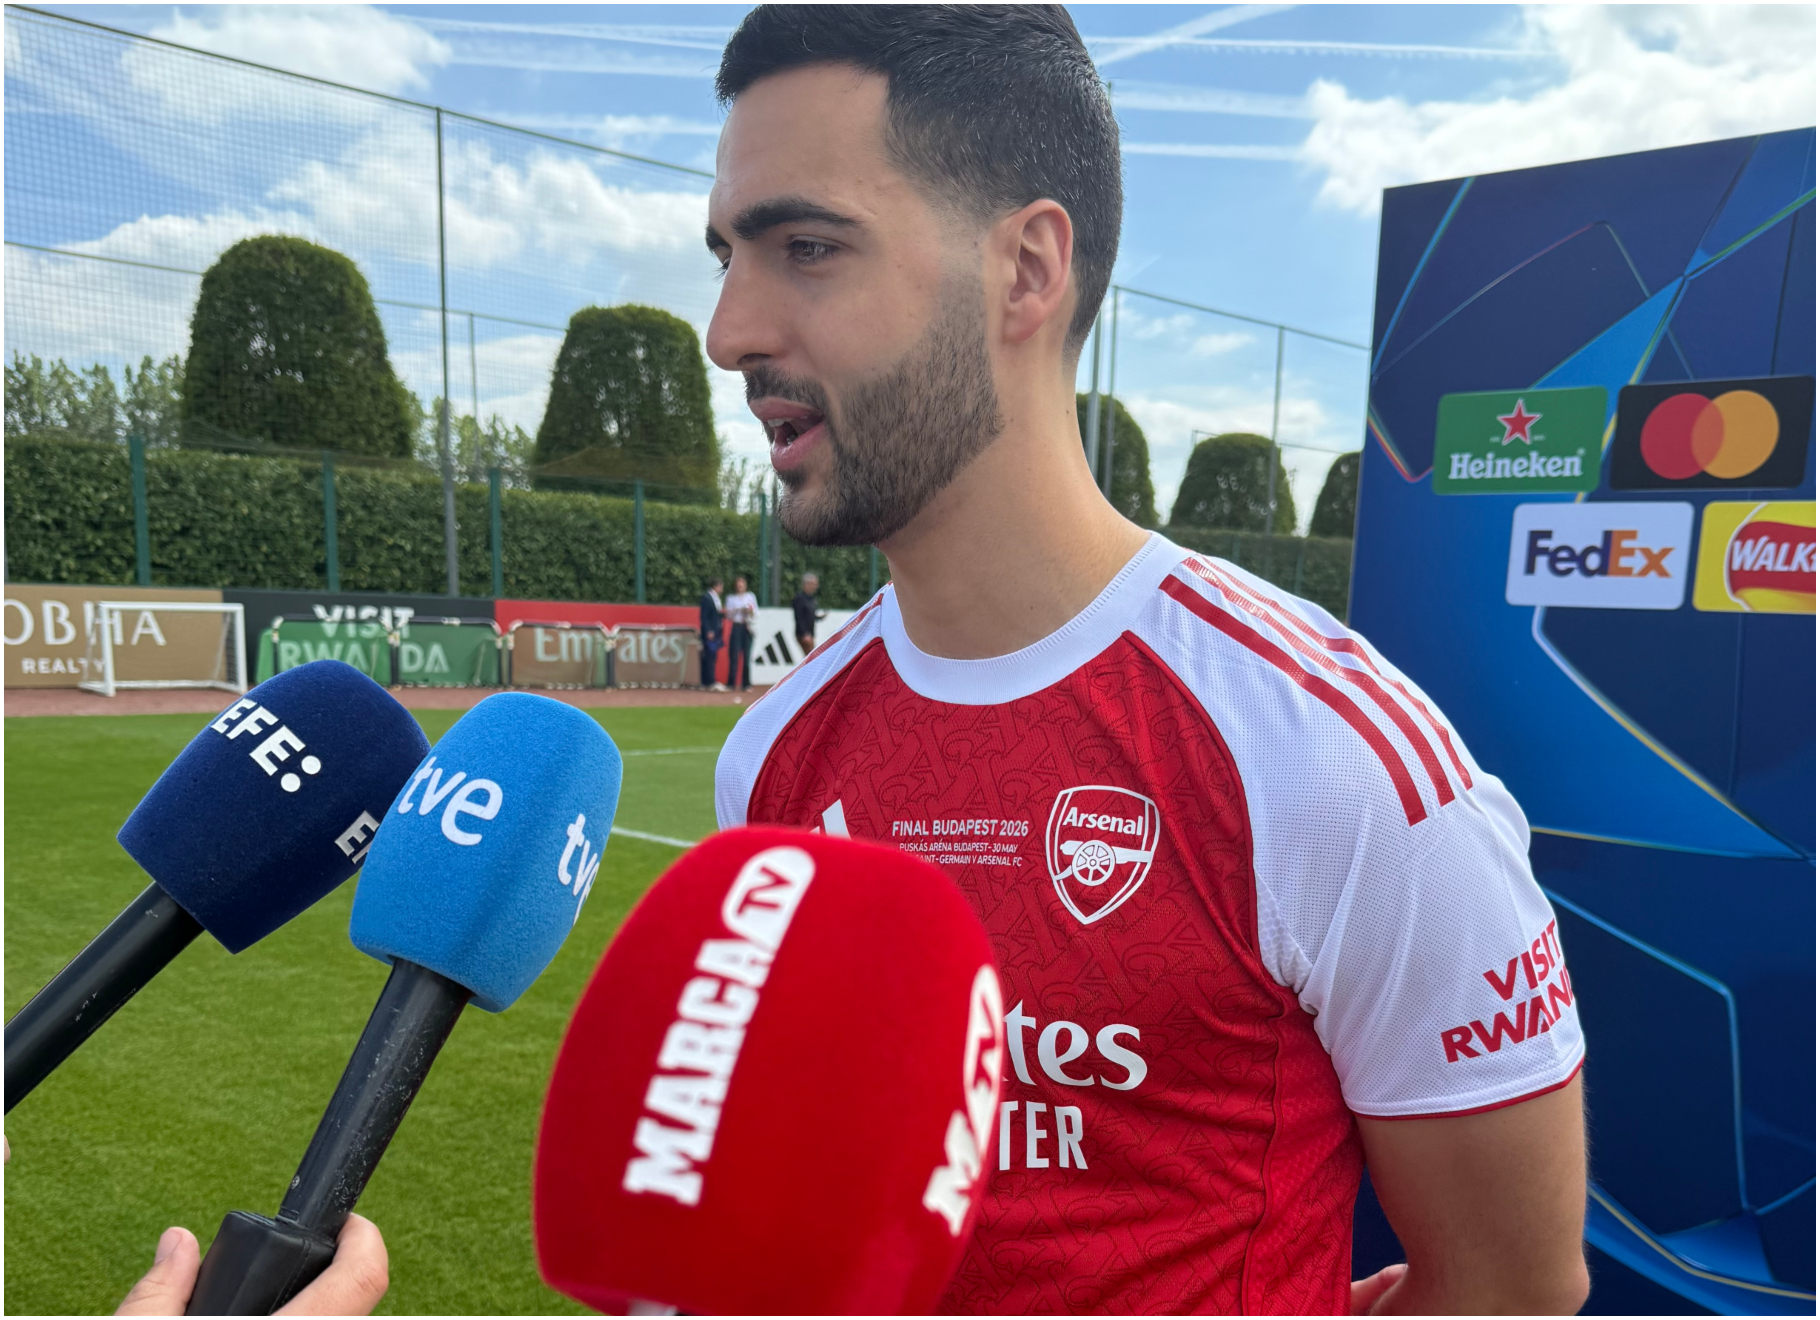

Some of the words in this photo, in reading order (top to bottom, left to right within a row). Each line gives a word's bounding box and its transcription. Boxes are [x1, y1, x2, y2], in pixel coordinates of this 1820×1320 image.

[1448, 450, 1584, 480] Heineken
[1524, 530, 1676, 578] FedEx
[312, 604, 415, 638] VISIT
[278, 640, 450, 674] RWADA
[398, 756, 504, 846] tve
[1062, 806, 1144, 836] Arsenal
[892, 820, 929, 837] FINAL
[932, 819, 998, 836] BUDAPEST
[999, 820, 1029, 837] 2026
[916, 854, 970, 865] AINT-GERMAIN
[977, 855, 1011, 866] ARSENAL
[1013, 857, 1022, 867] FC
[1482, 918, 1561, 1001] VISIT
[1440, 963, 1574, 1063] RWAN
[622, 937, 776, 1207] MARCA
[999, 1100, 1089, 1172] TER
